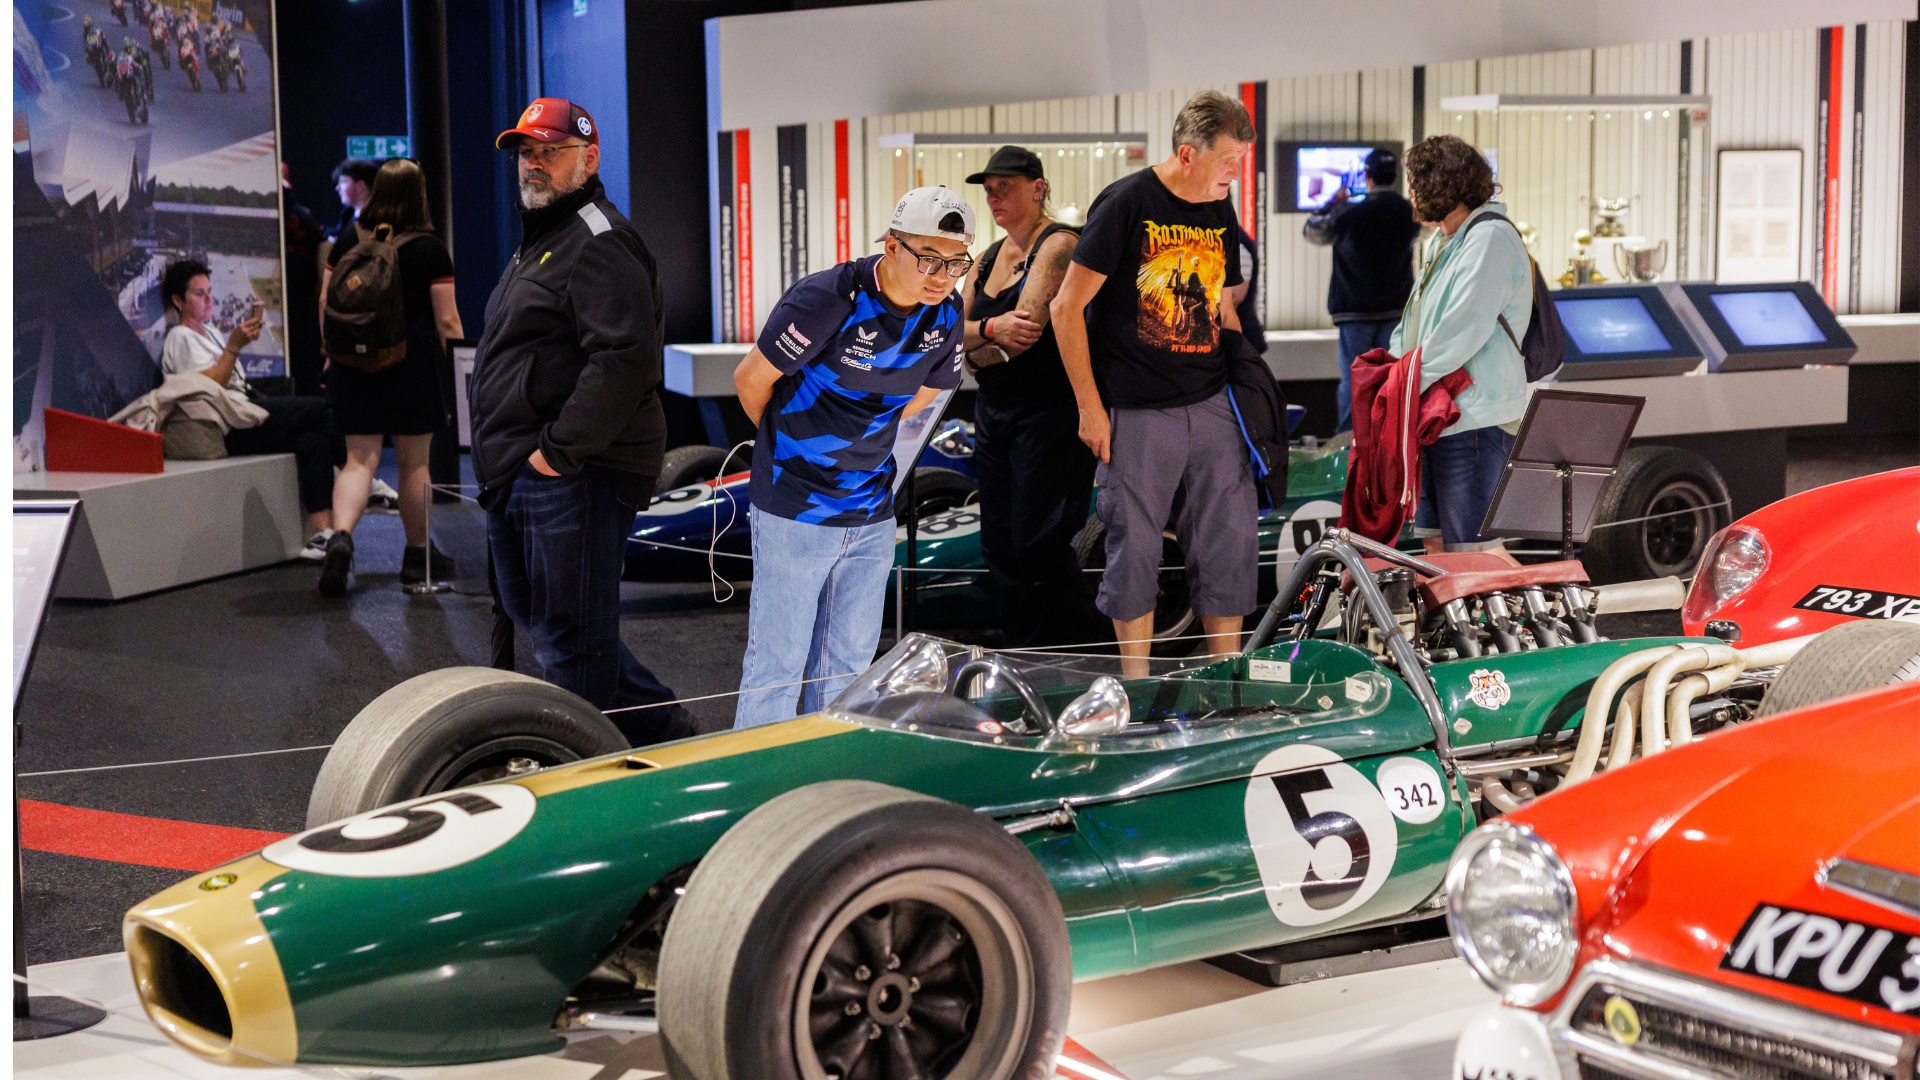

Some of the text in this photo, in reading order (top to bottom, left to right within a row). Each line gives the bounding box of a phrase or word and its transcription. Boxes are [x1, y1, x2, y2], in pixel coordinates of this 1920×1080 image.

[1803, 587, 1872, 613] 793
[297, 792, 503, 855] 5
[1394, 782, 1438, 810] 342
[1270, 768, 1370, 911] 5
[1730, 905, 1894, 993] KPU
